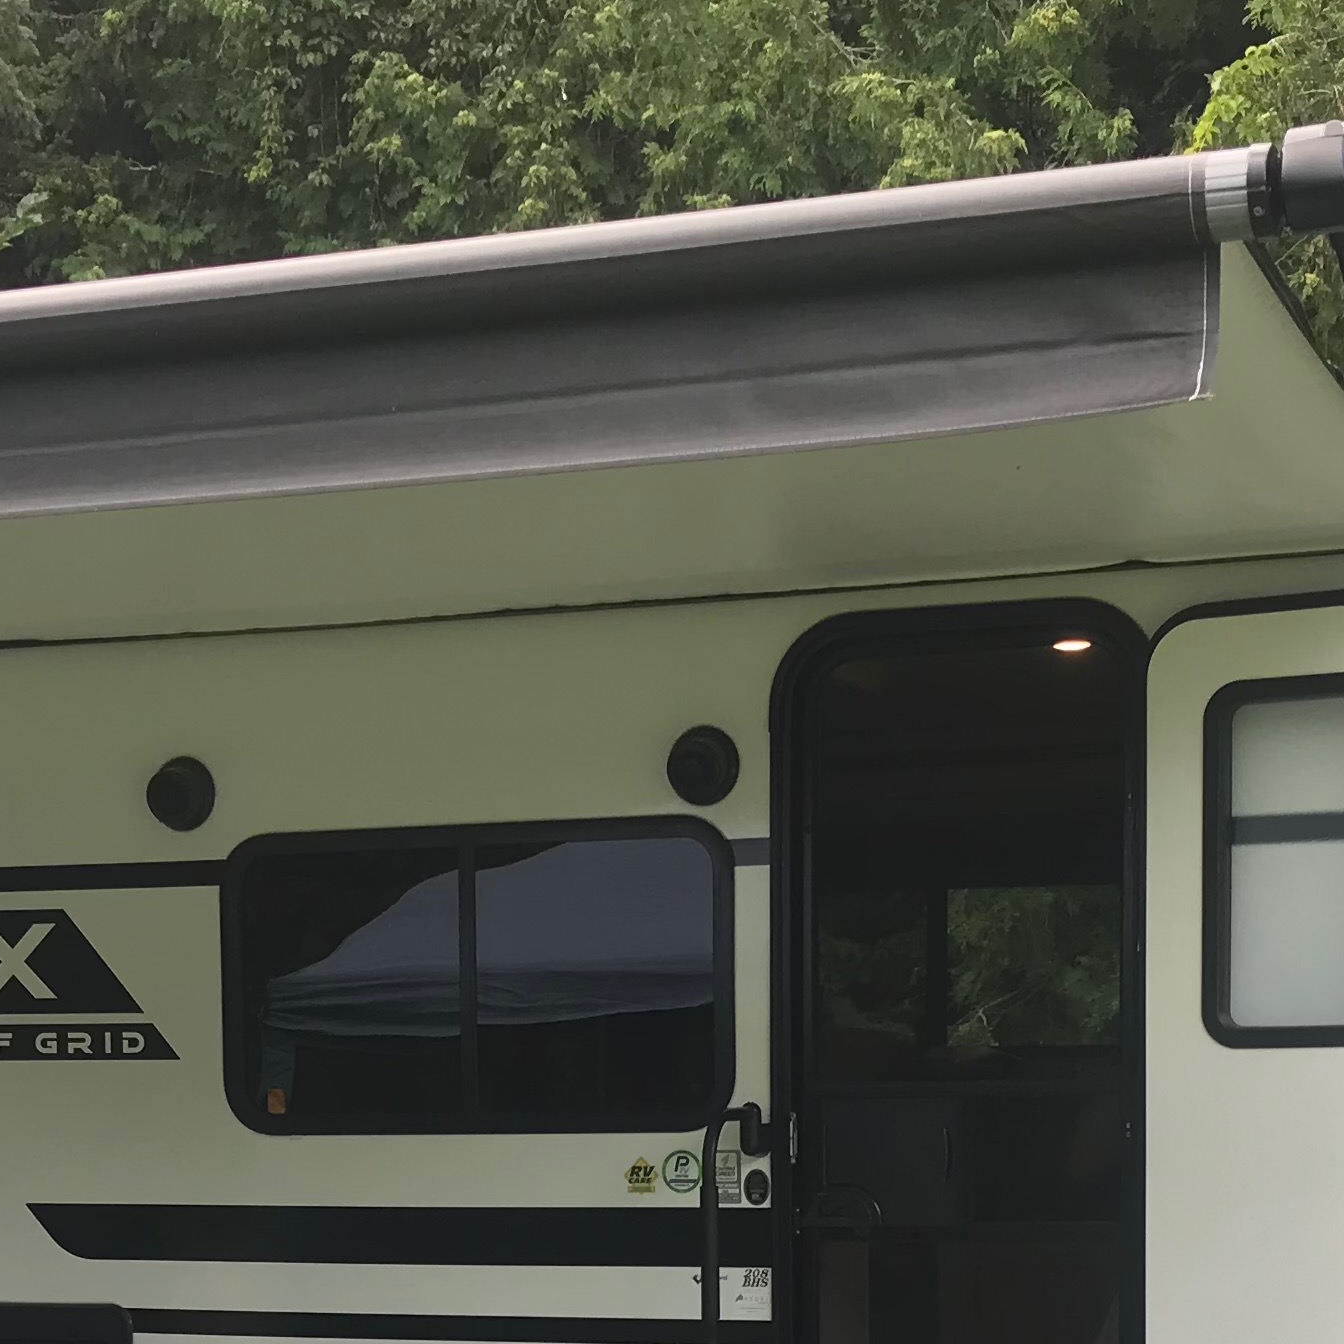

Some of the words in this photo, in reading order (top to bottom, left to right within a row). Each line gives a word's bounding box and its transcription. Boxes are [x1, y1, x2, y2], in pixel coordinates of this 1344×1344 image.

[35, 1032, 145, 1055] GRID
[630, 1165, 656, 1177] RV
[743, 1268, 769, 1279] 208
[742, 1278, 769, 1288] BHS
